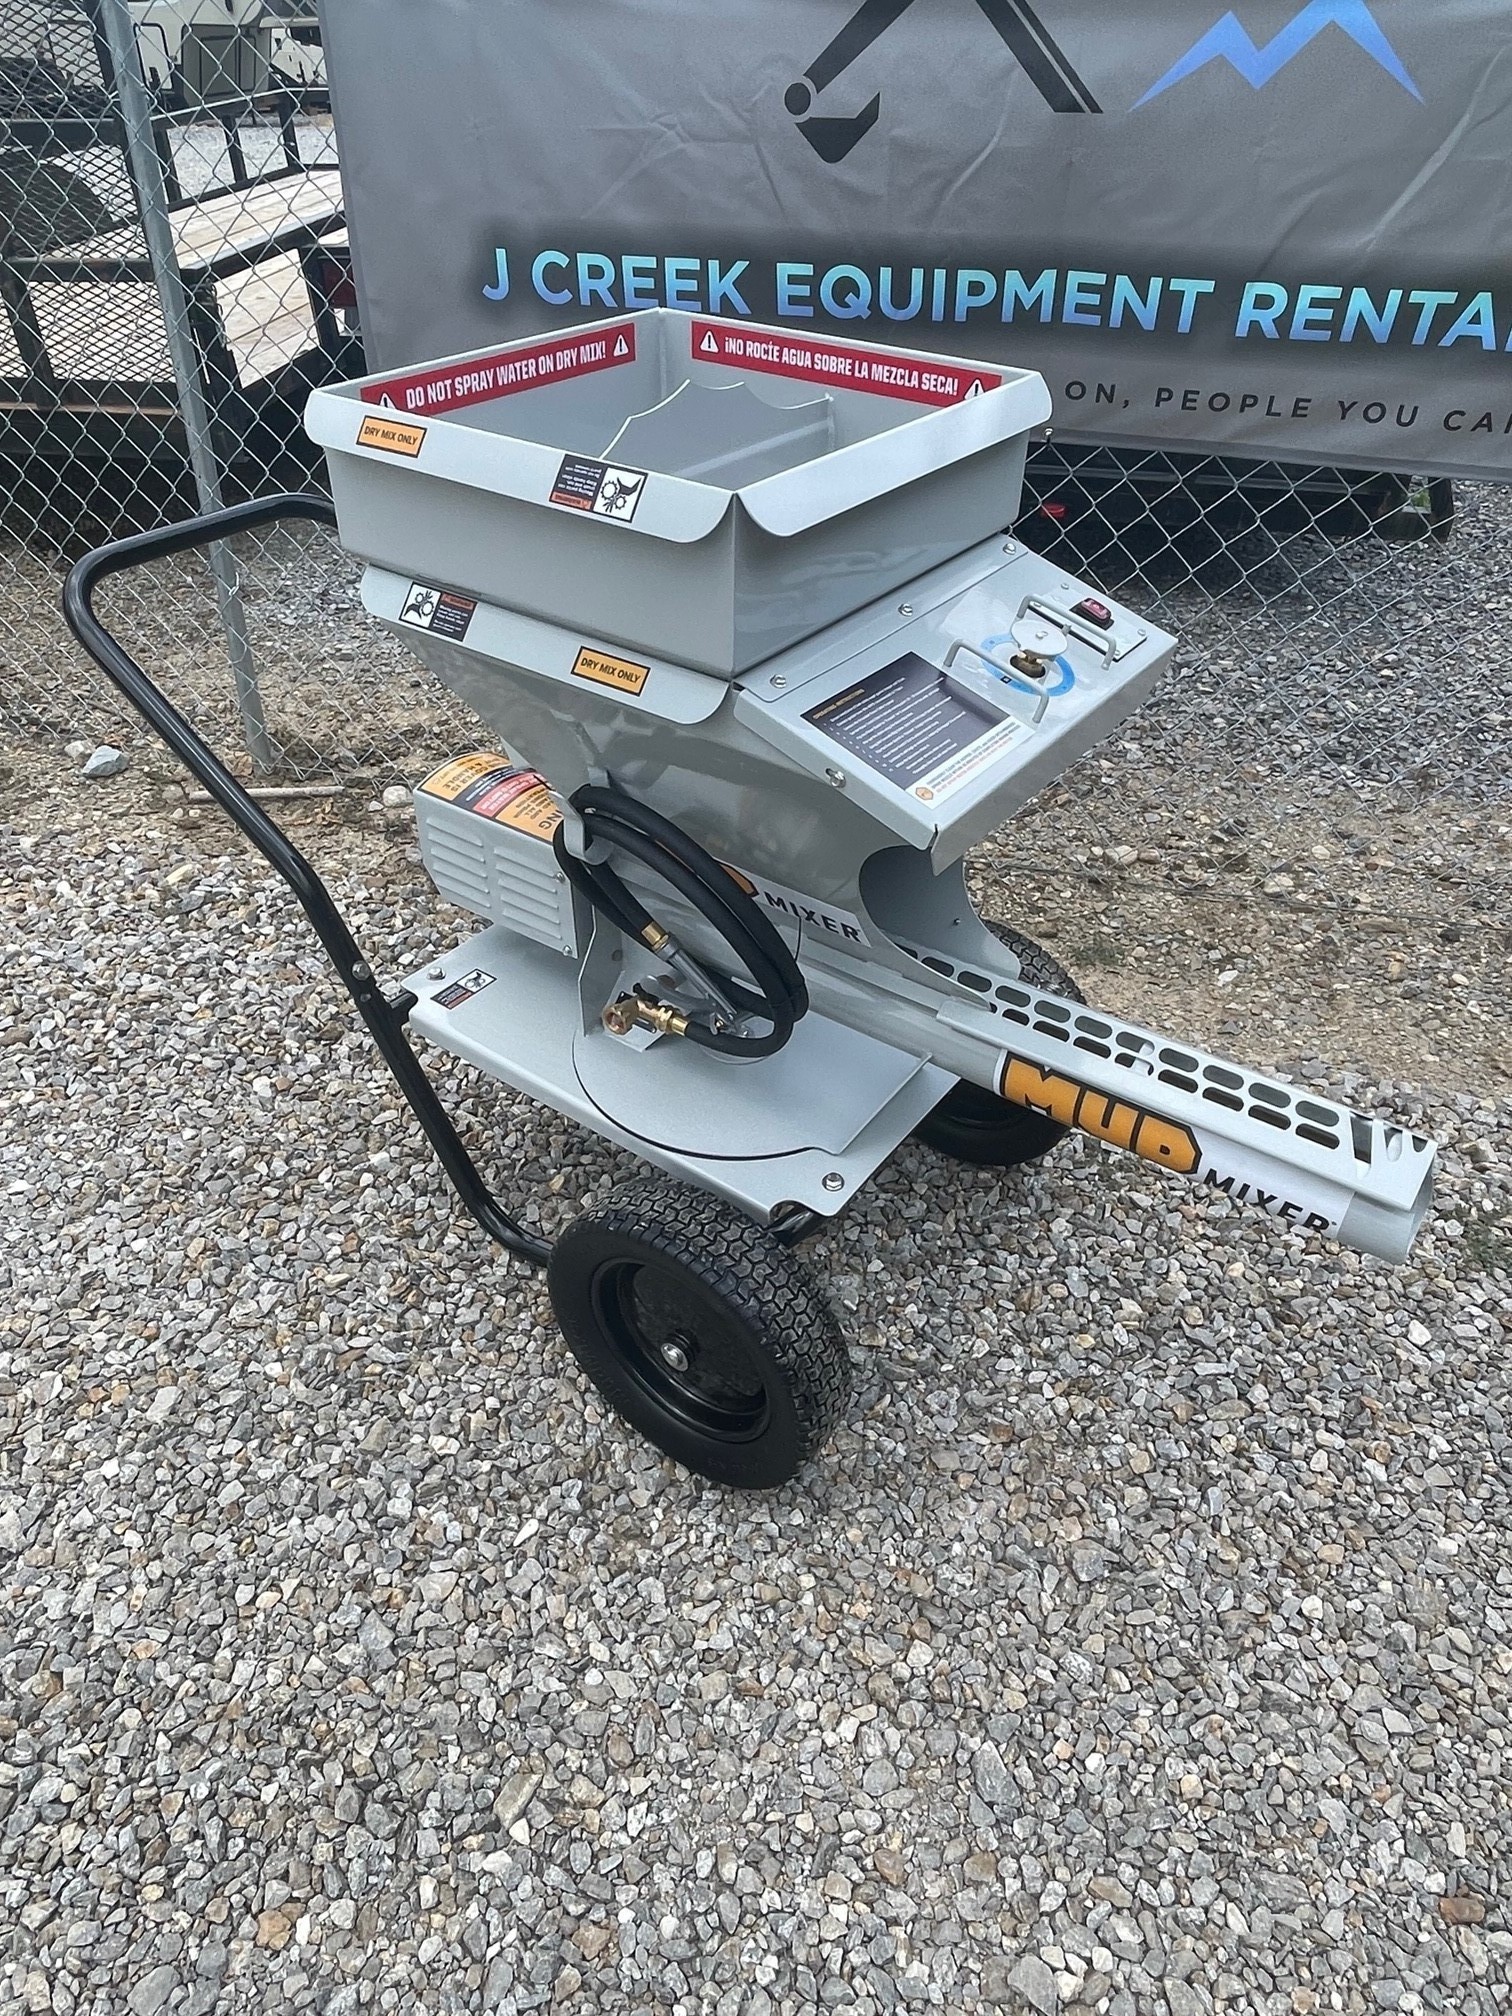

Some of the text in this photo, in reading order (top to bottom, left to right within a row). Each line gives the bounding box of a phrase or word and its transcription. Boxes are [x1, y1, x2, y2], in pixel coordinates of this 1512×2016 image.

[482, 247, 510, 301] J
[531, 249, 752, 315] CREEK
[775, 261, 1216, 334] EQUIPMENT
[405, 340, 607, 410] DO NOT SPRAY WATER ON DRY MIX!
[745, 339, 780, 363] ROCÍE
[781, 346, 812, 369] AGUA
[813, 354, 853, 377] SOBRE
[854, 359, 869, 380] LA
[871, 364, 919, 389] MEZCLA
[921, 372, 959, 397] SECA!
[1064, 379, 1130, 409] ON,
[1154, 386, 1313, 419] PEOPLE
[1338, 400, 1420, 428] YOU
[363, 425, 419, 446] DRY MIX ONLY
[580, 657, 642, 684] DRY MIX ONLY
[763, 890, 862, 944] MIXER
[1000, 1051, 1331, 1234] MUD MIXER
